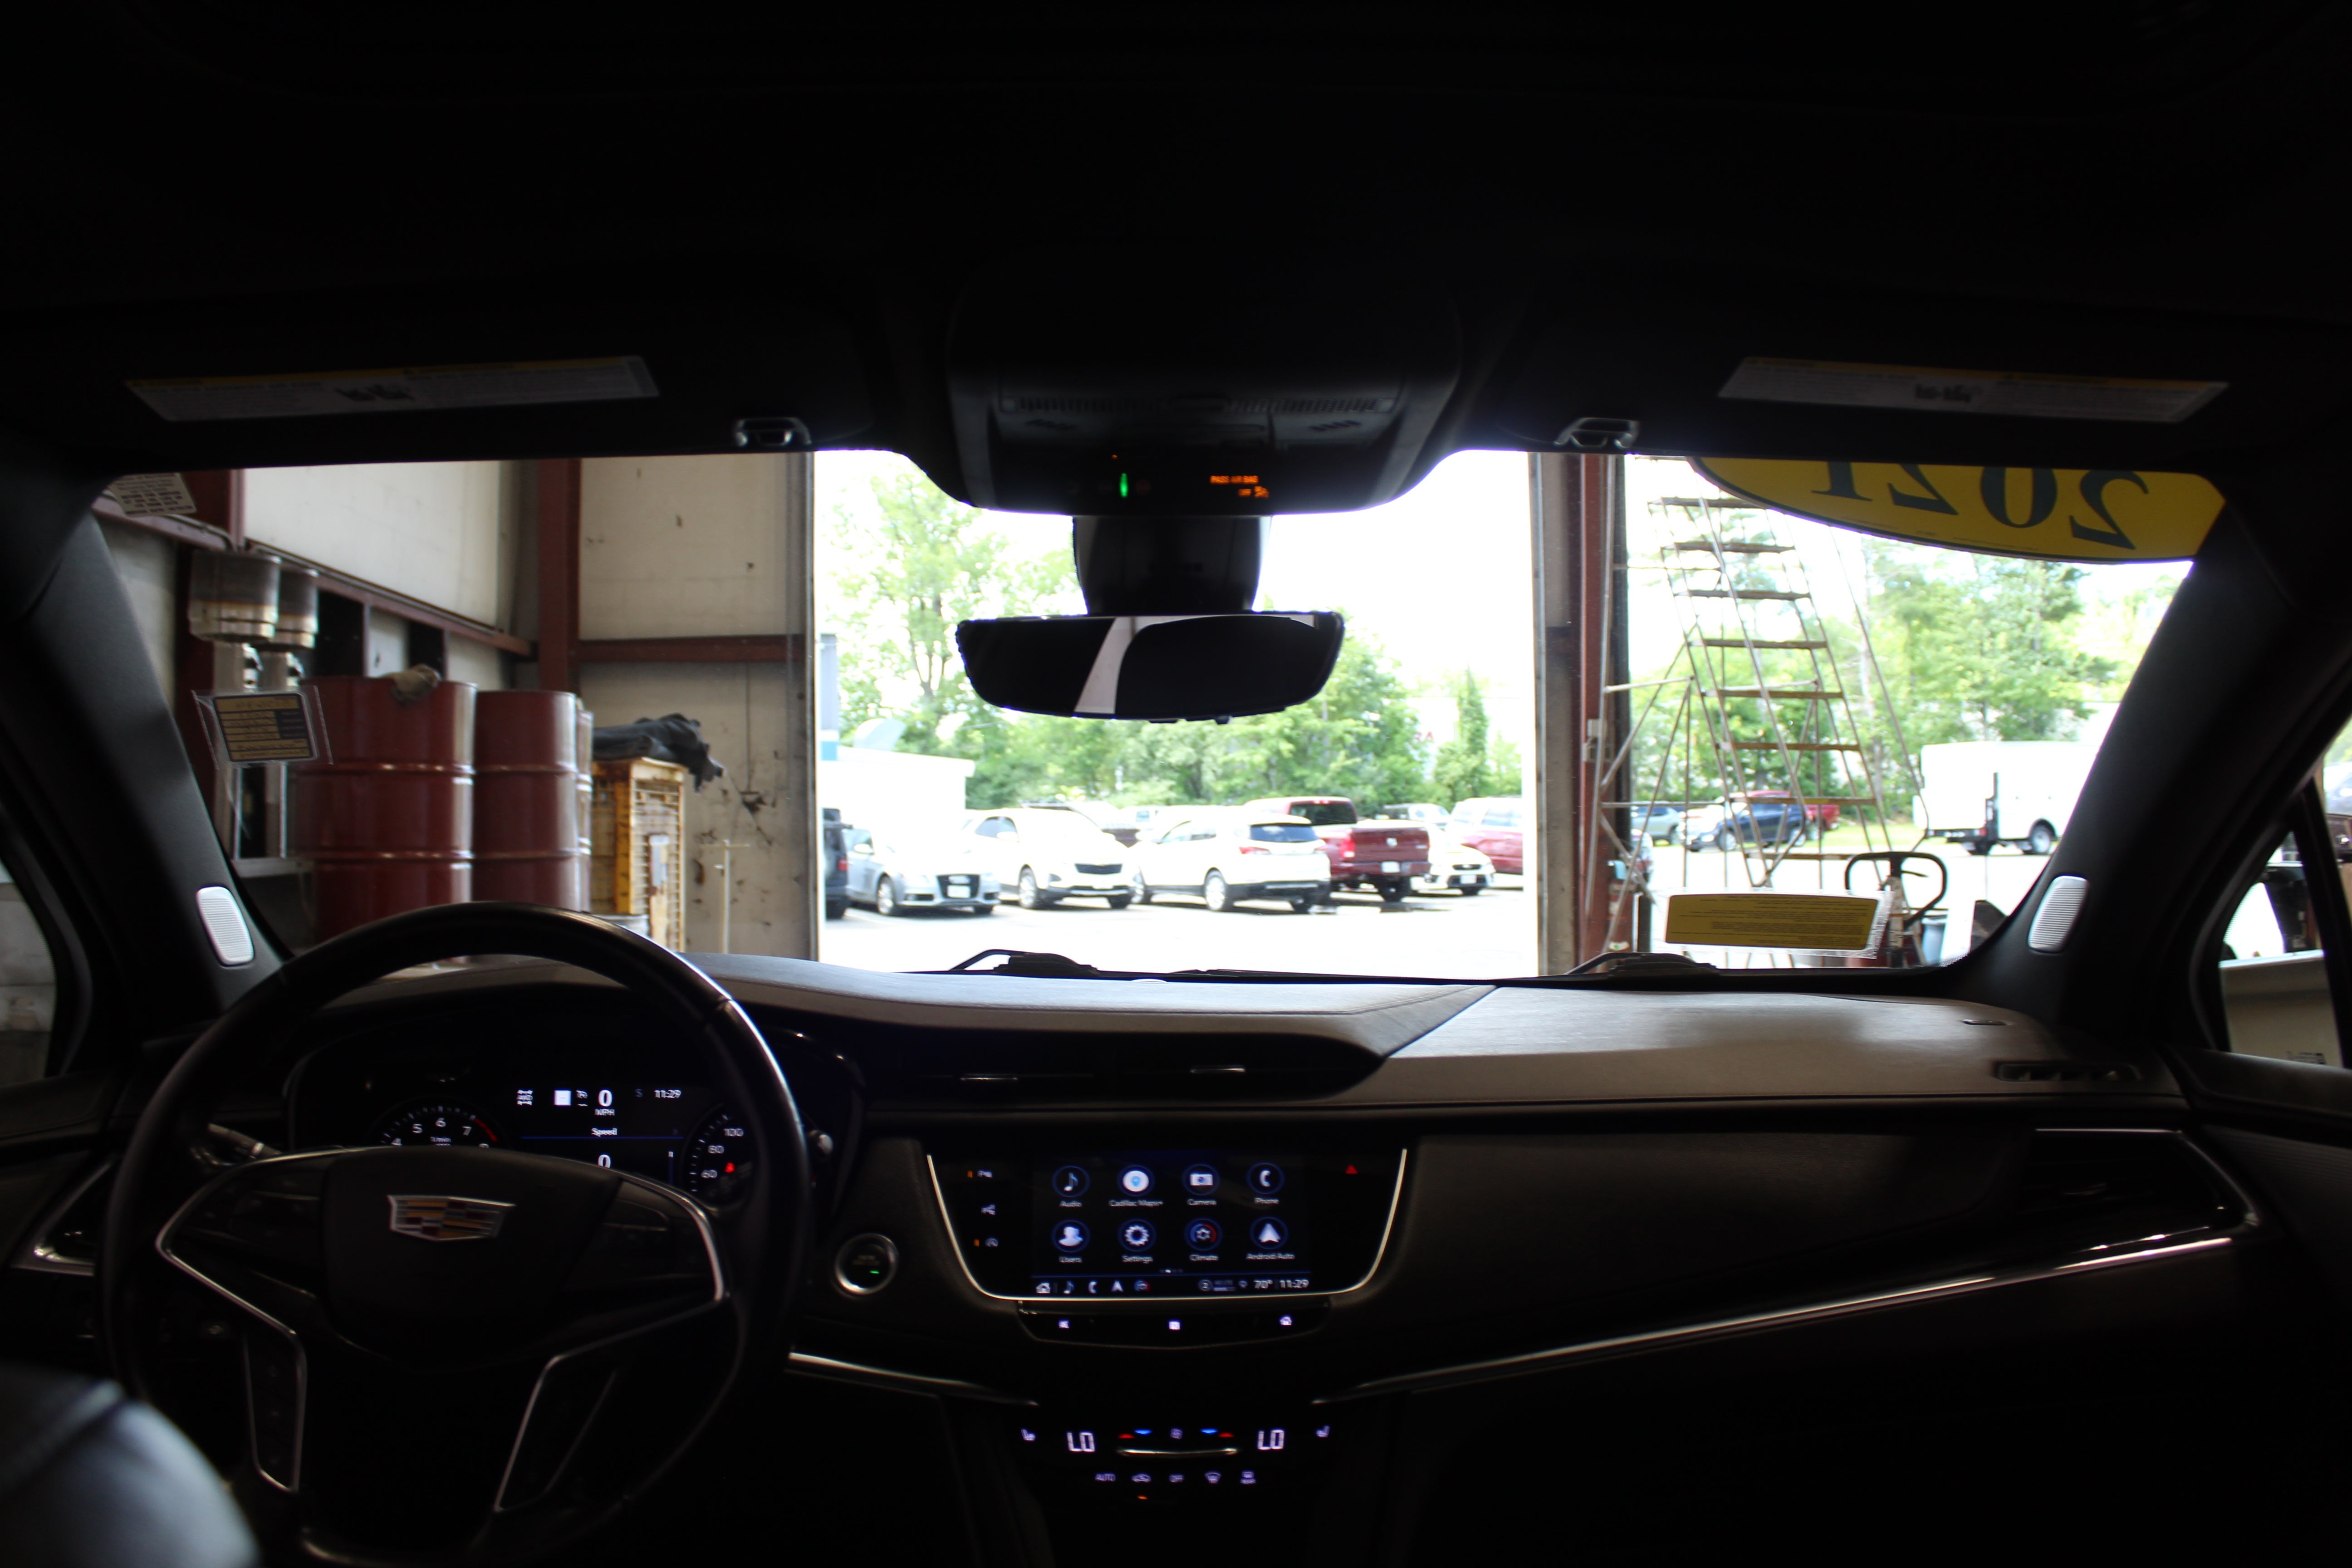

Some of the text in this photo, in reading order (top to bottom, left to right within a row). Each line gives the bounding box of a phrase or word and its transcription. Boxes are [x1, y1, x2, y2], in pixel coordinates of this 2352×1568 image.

[654, 1089, 681, 1098] 11:29
[436, 1117, 446, 1127] 6
[412, 1123, 422, 1133] 5
[462, 1126, 472, 1136] 7
[591, 1127, 617, 1137] Speed
[724, 1128, 744, 1137] 100
[708, 1145, 725, 1154] 80
[701, 1169, 717, 1178] 60
[1122, 1255, 1153, 1264] Settings
[1279, 1279, 1309, 1288] 11:29
[1067, 1432, 1095, 1452] LO
[1257, 1429, 1284, 1450] LO
[1095, 1473, 1116, 1481] AUTO
